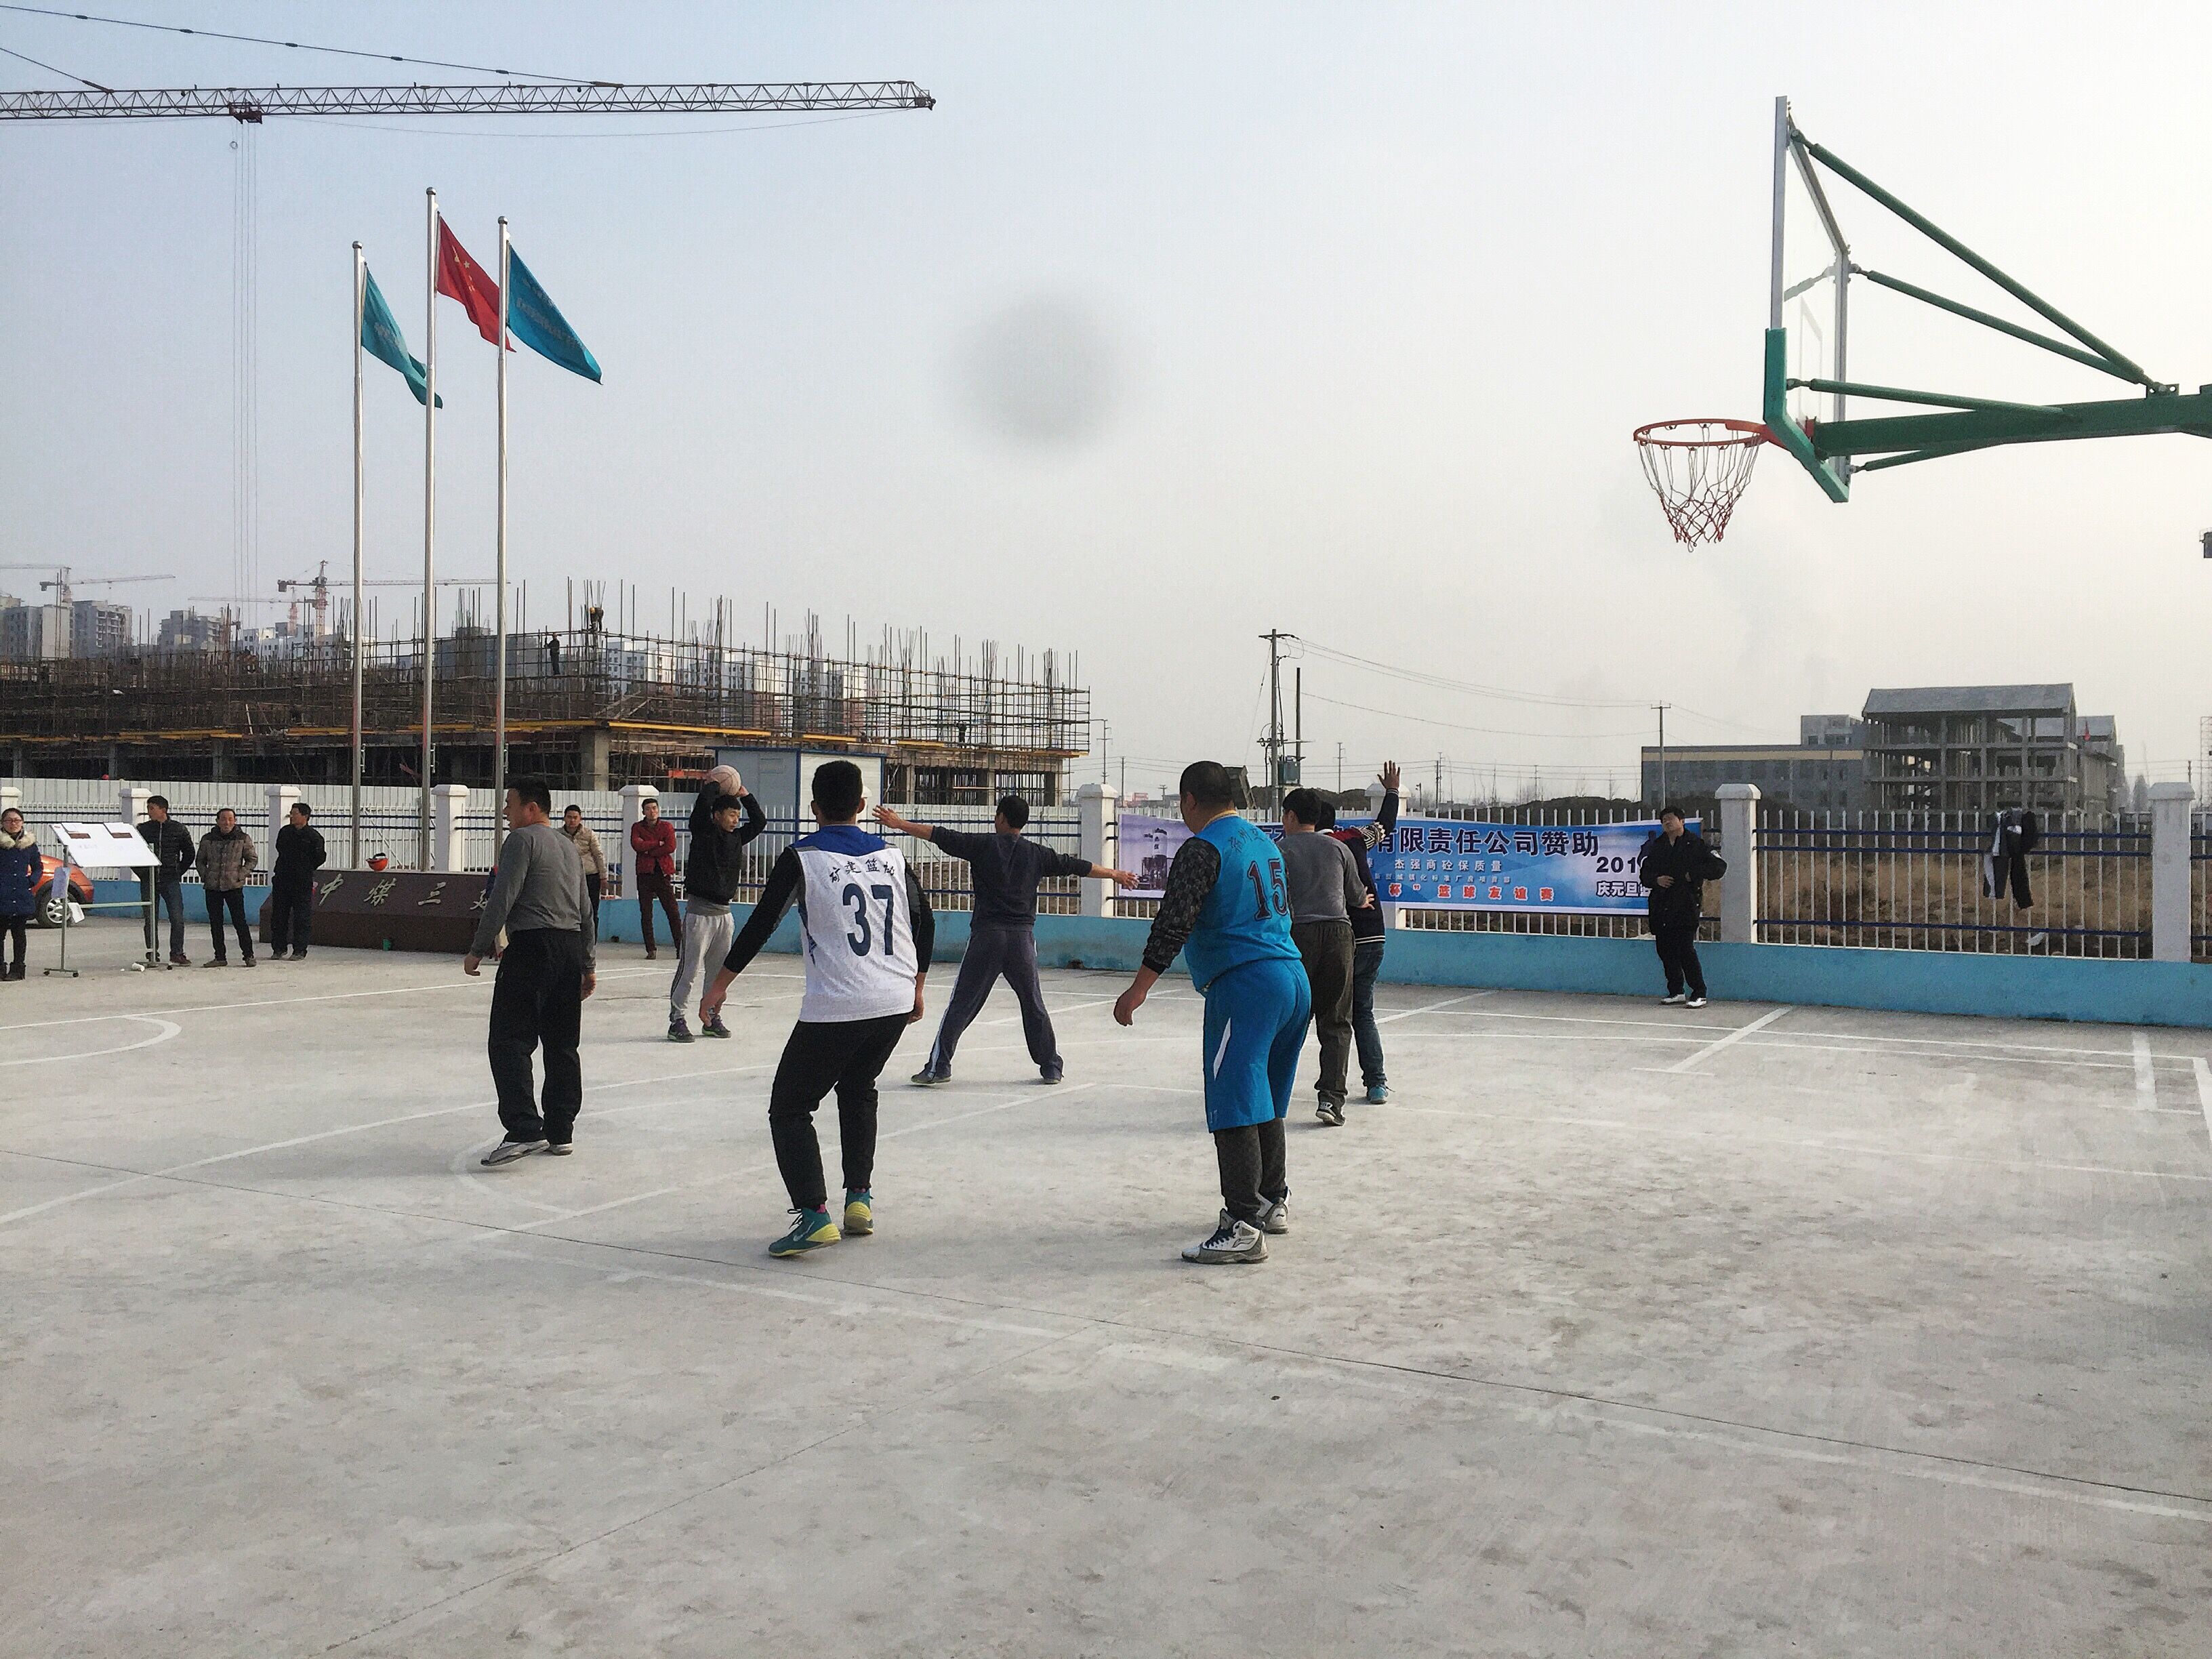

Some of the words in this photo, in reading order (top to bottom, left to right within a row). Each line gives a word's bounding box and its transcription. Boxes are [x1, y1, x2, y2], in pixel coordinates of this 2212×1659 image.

[1394, 858, 1502, 872] 杰强商砼保质量
[1596, 856, 1648, 874] 201
[1247, 858, 1288, 922] 15
[842, 882, 894, 957] 37
